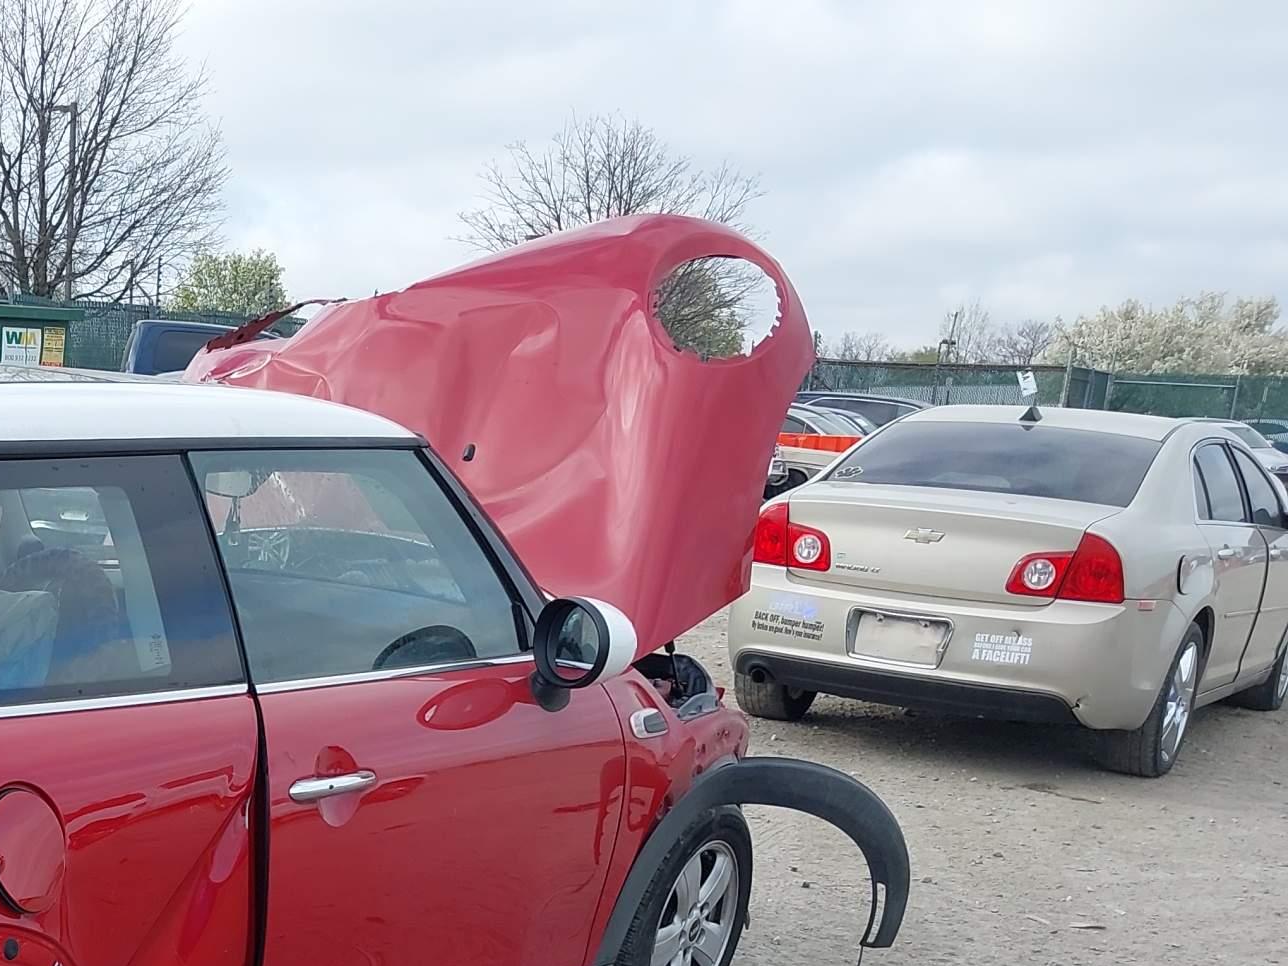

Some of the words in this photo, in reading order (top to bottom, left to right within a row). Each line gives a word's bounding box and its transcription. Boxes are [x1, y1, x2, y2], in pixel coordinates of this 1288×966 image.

[754, 610, 769, 620] BACK
[975, 633, 990, 642] GET
[990, 634, 1004, 644] OFF
[1017, 635, 1032, 646] ASS
[972, 648, 980, 660] A
